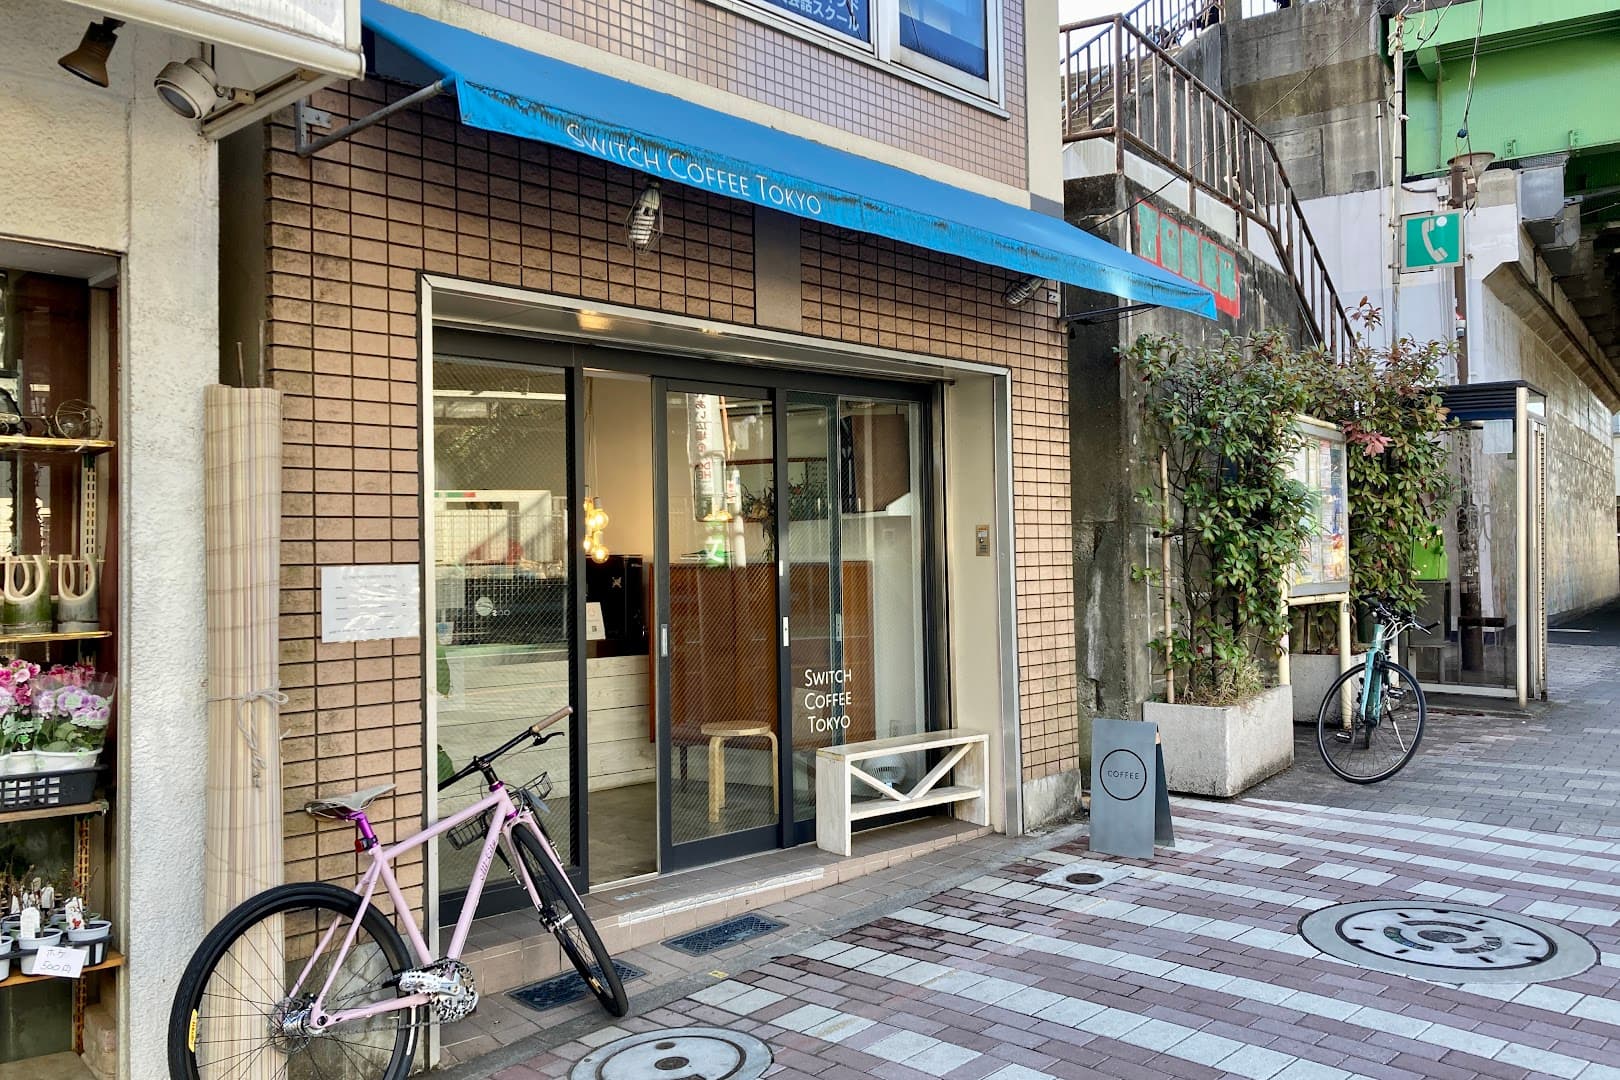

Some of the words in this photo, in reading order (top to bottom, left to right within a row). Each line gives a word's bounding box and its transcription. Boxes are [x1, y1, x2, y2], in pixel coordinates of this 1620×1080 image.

[566, 123, 661, 172] SWITCH
[667, 152, 750, 197] COFFEE
[755, 174, 822, 215] TOKYO
[804, 668, 852, 687] SWITCH
[804, 691, 852, 710] COFFEE
[807, 715, 851, 734] TOKYO
[1107, 770, 1140, 780] COFFEE
